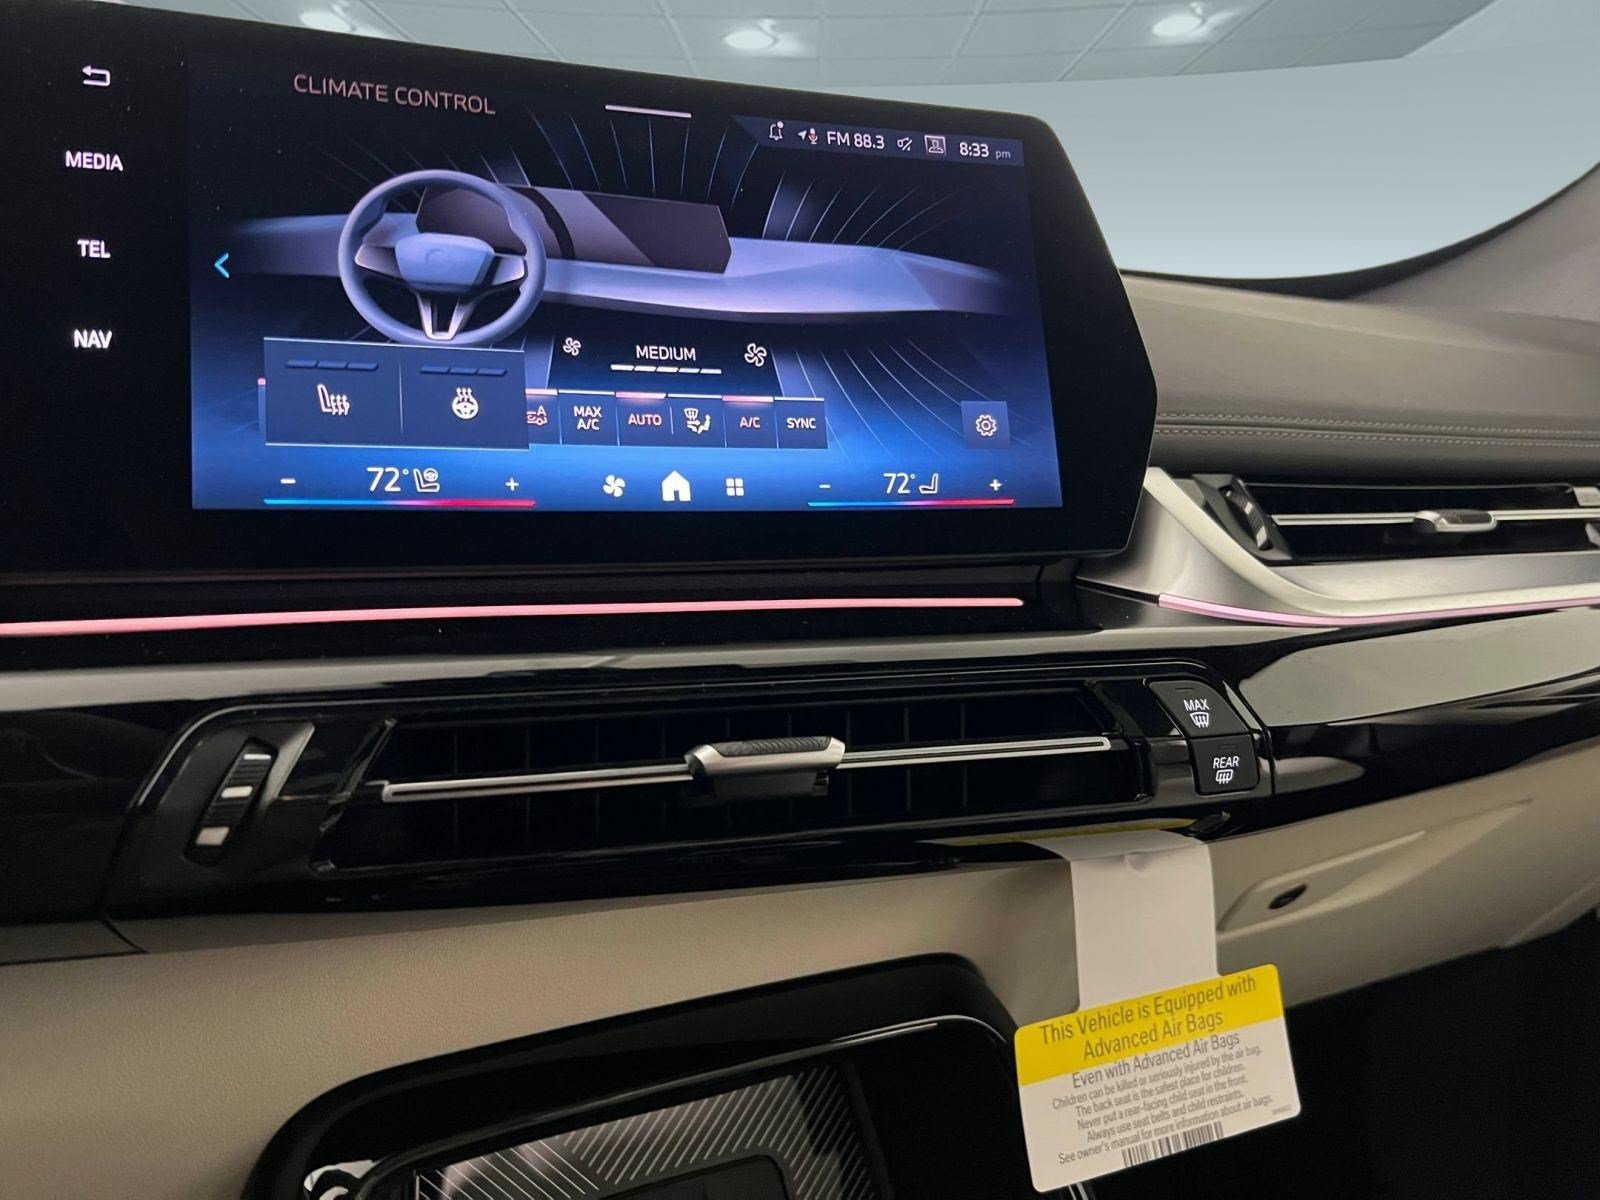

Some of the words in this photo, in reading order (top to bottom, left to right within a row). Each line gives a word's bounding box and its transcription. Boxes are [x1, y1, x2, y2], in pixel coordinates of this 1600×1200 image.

[293, 73, 388, 103] CLIMATE
[395, 86, 496, 115] CONTROL
[827, 131, 850, 147] FM
[854, 133, 885, 149] 88.3
[959, 142, 990, 158] 8:33
[995, 150, 1011, 160] pm
[65, 150, 123, 172] MEDIA
[77, 239, 111, 259] TEL
[73, 329, 113, 350] NAV
[635, 345, 696, 361] MEDIUM
[573, 406, 602, 418] MAX
[628, 413, 662, 426] AUTO
[577, 418, 600, 430] A/C
[739, 416, 760, 429] A/C
[786, 417, 816, 429] SYNC
[1183, 698, 1210, 711] MAX
[1212, 756, 1240, 769] REAR
[1039, 1023, 1074, 1045] This
[1076, 1006, 1134, 1035] Vehicle
[1138, 1003, 1149, 1020] is
[1153, 982, 1223, 1019] Equipped
[1226, 975, 1256, 998] with
[1083, 1027, 1159, 1061] Advanced
[1162, 1019, 1182, 1038] Air
[1186, 1011, 1224, 1033] Bags
[1072, 1070, 1103, 1088] Even
[1104, 1061, 1131, 1080] with
[1133, 1042, 1191, 1072] Advanced
[1193, 1038, 1209, 1056] Air
[1210, 1033, 1240, 1050] Bags
